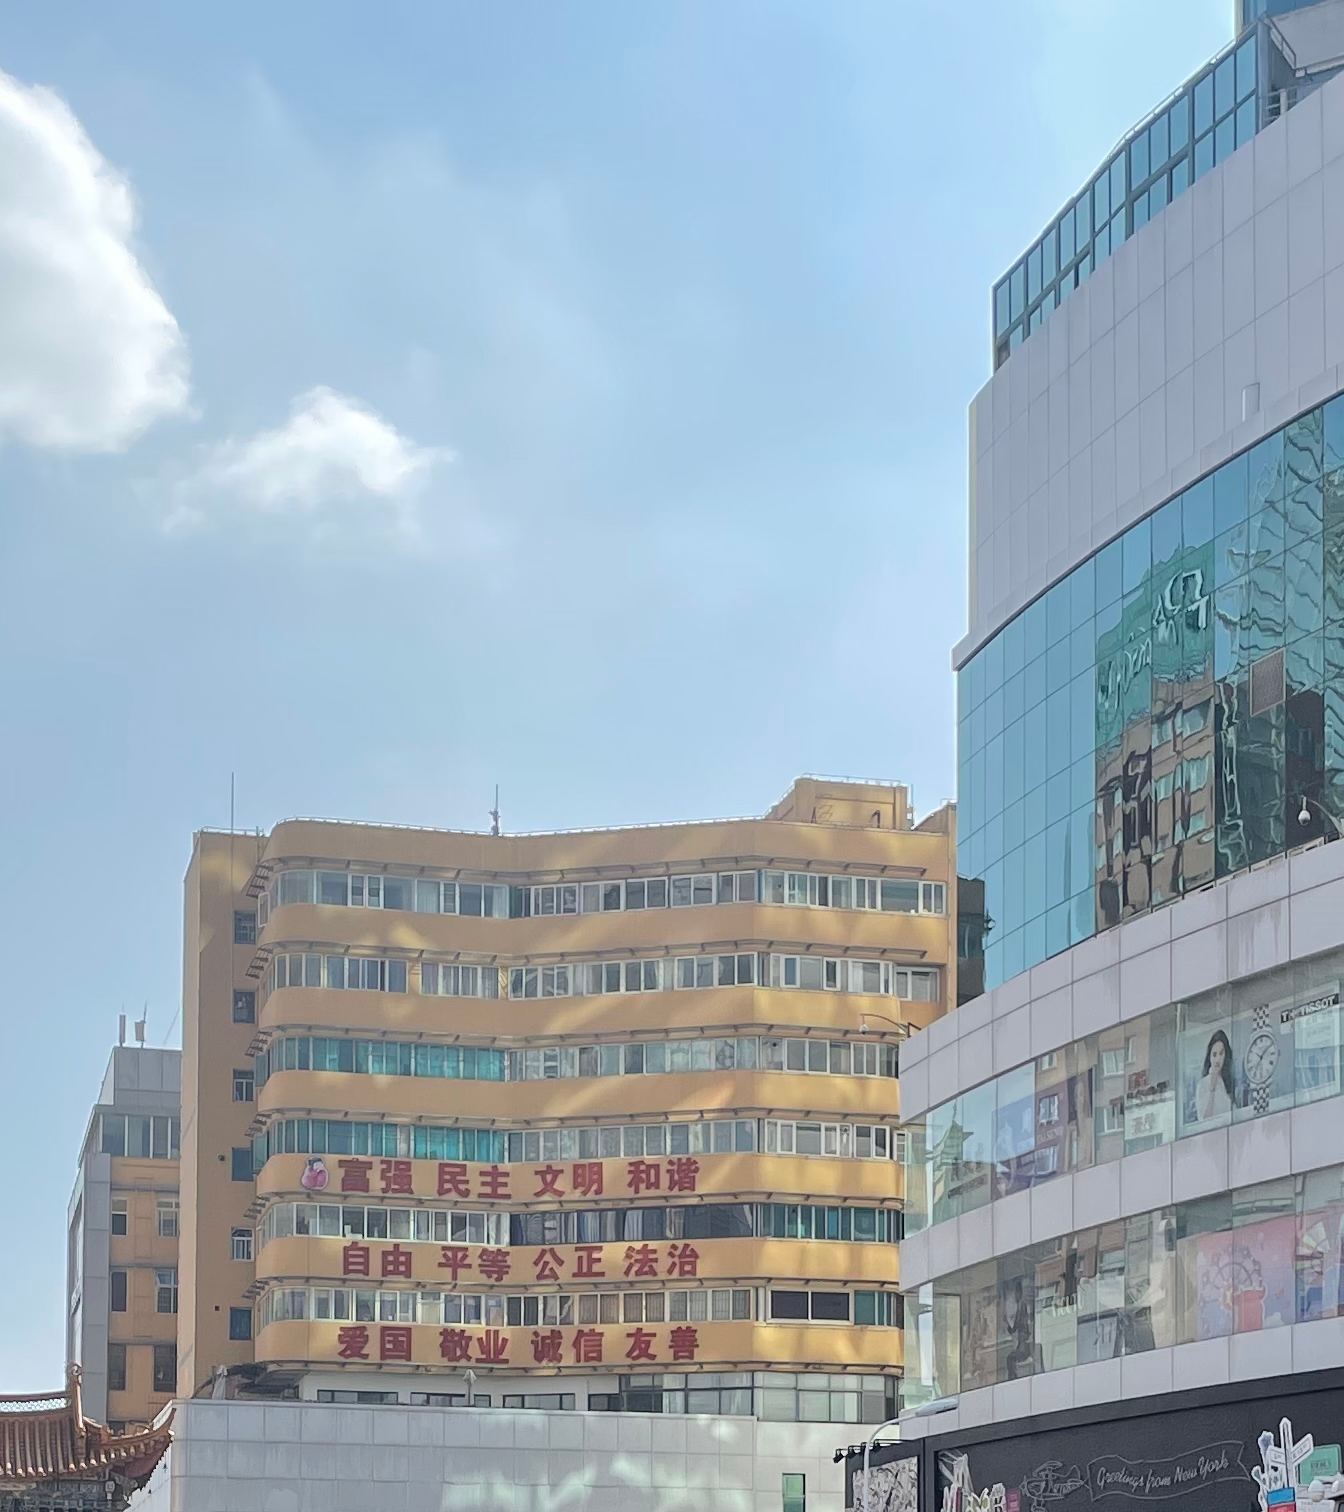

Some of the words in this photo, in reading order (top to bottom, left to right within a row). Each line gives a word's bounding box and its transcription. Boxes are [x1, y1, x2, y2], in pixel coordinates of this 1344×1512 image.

[1299, 995, 1336, 1016] TISSOT
[338, 1158, 414, 1195] 富强
[437, 1162, 512, 1200] 民主
[534, 1162, 604, 1197] 文明
[627, 1157, 700, 1194] 和谐
[342, 1241, 412, 1279] 自由
[437, 1246, 511, 1283] 平等
[533, 1246, 605, 1281] 公正
[623, 1243, 700, 1278] 法治
[338, 1326, 412, 1362] 爱国
[439, 1328, 509, 1364] 敬业
[531, 1329, 604, 1363] 诚信
[626, 1326, 699, 1361] 友善
[1096, 1467, 1144, 1493] Greetings
[1145, 1469, 1171, 1494] from
[1174, 1466, 1198, 1484] New
[1197, 1450, 1230, 1480] York
